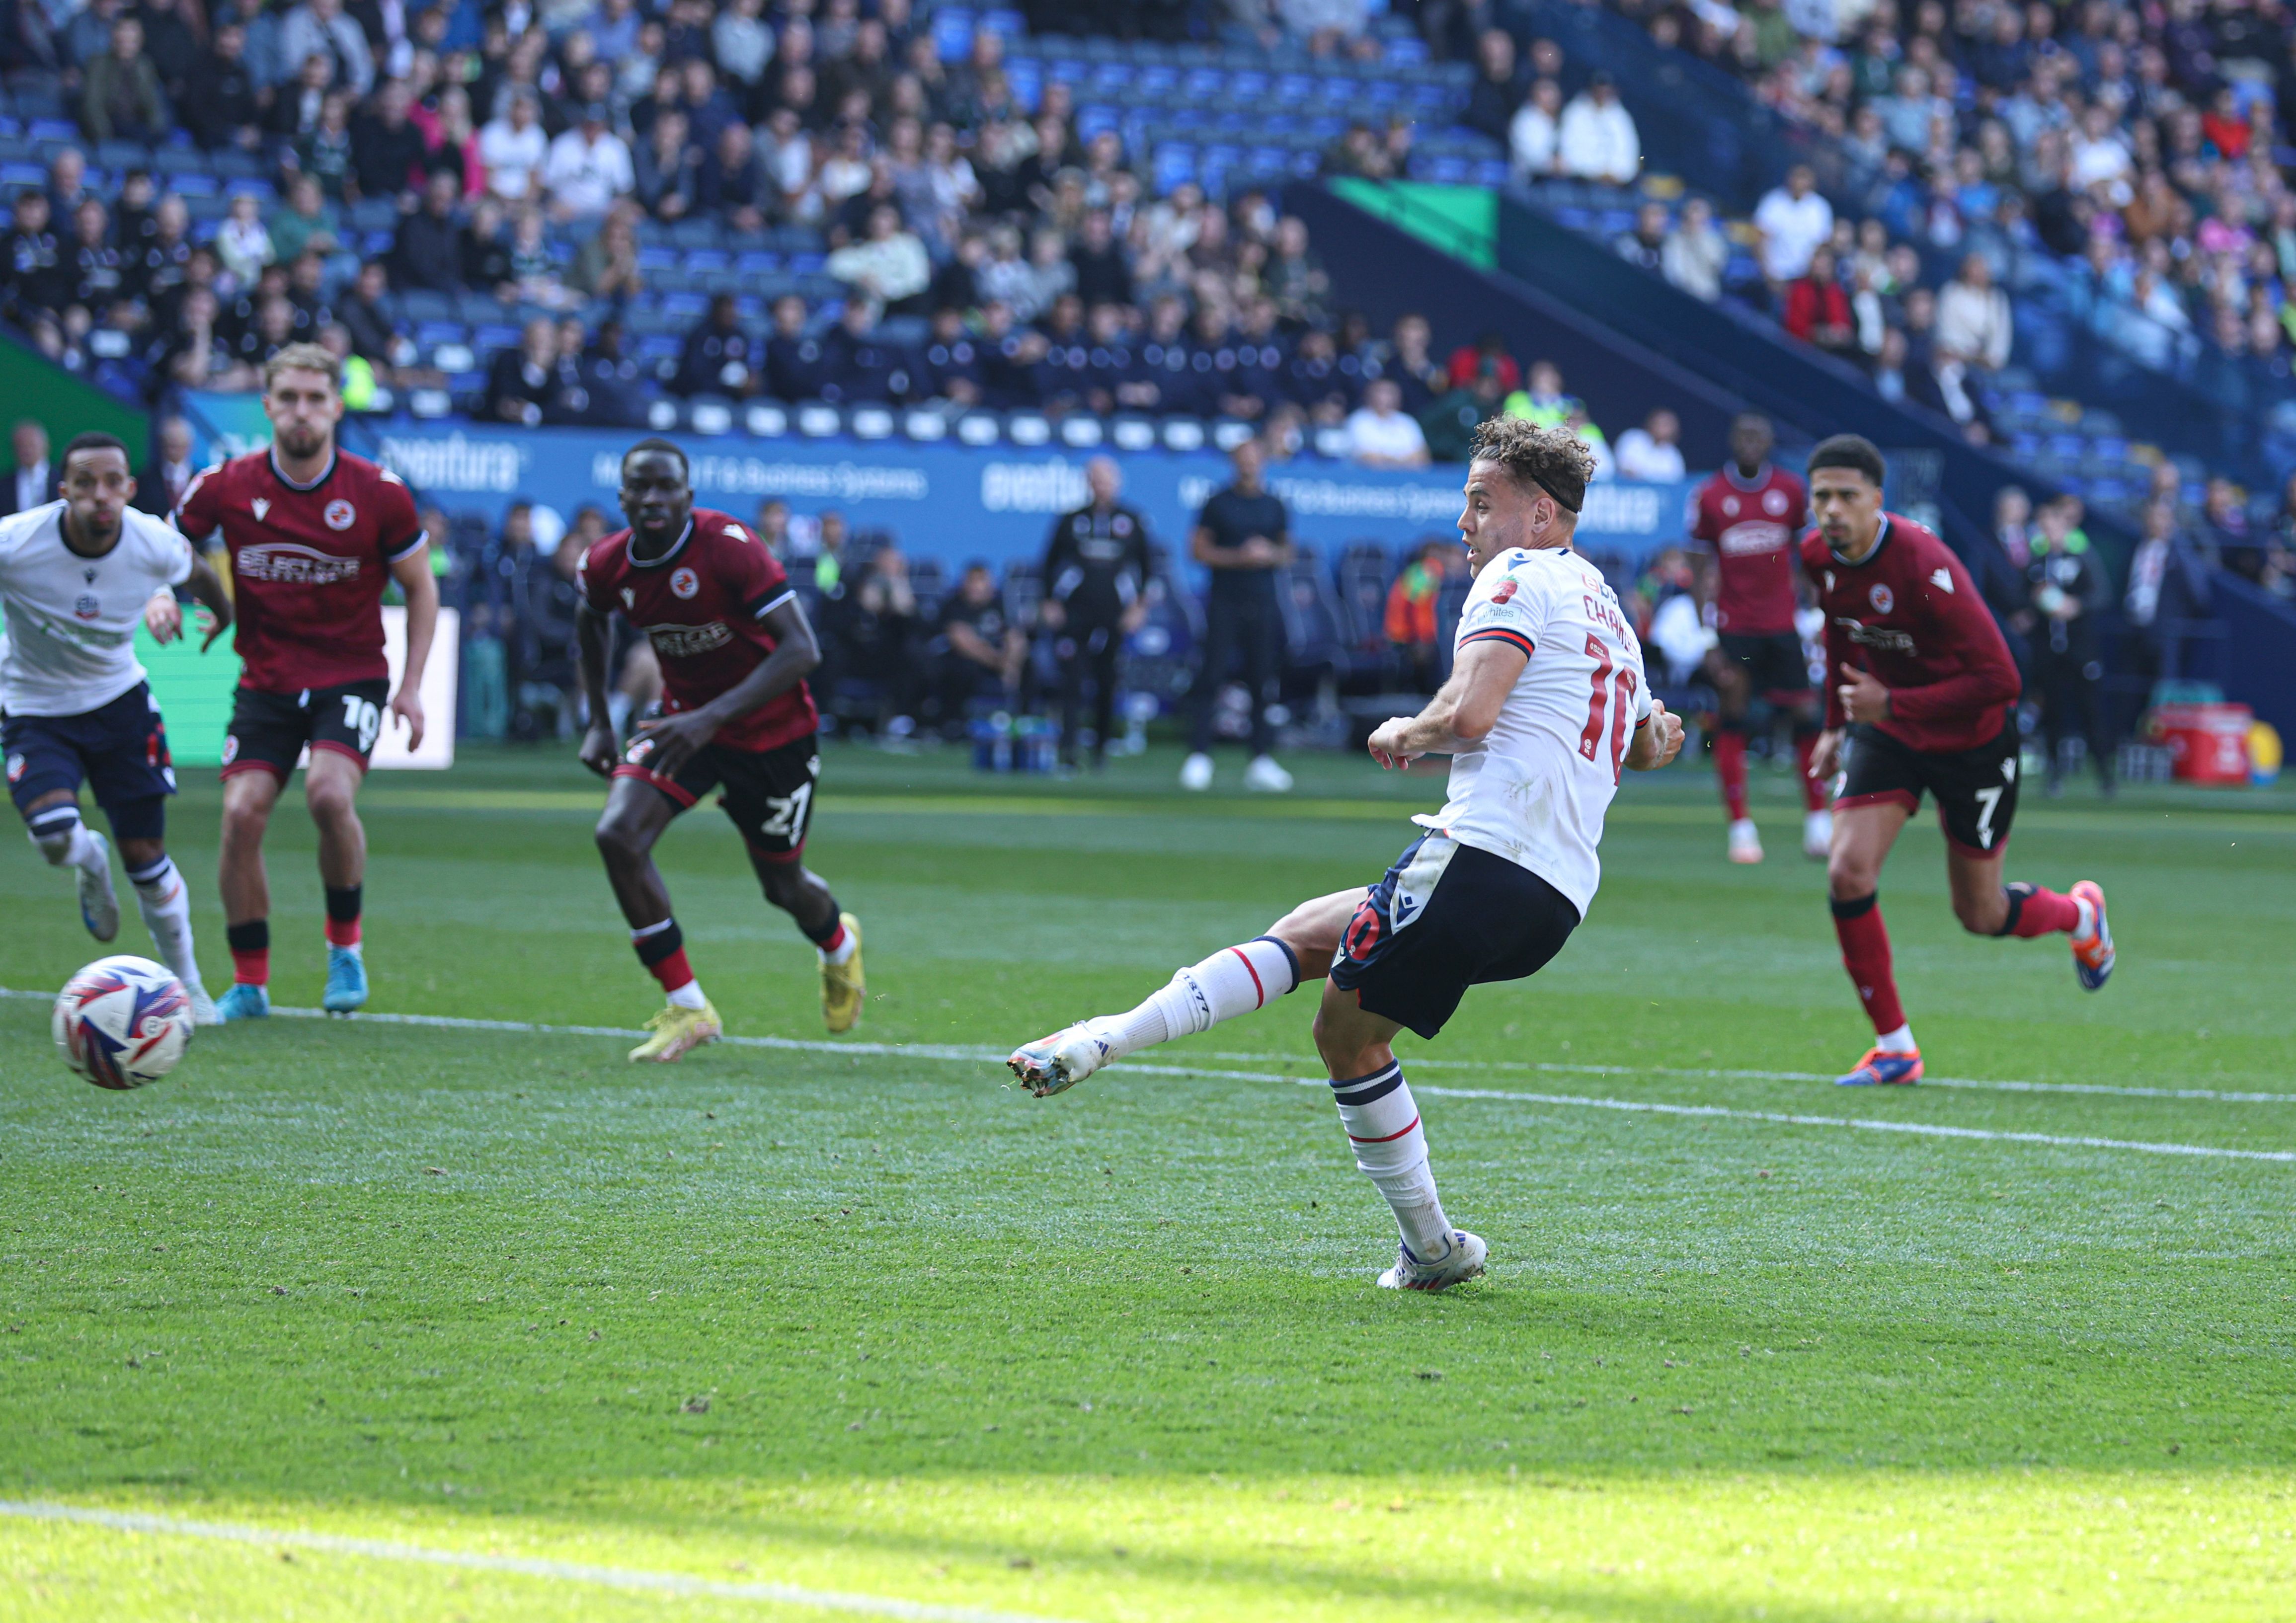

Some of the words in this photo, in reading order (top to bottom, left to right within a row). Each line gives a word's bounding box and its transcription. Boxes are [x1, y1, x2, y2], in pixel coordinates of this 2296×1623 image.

[1483, 606, 1514, 618] whites
[1583, 595, 1640, 662] CHARL
[760, 781, 812, 836] 27
[1974, 786, 2004, 832] 7
